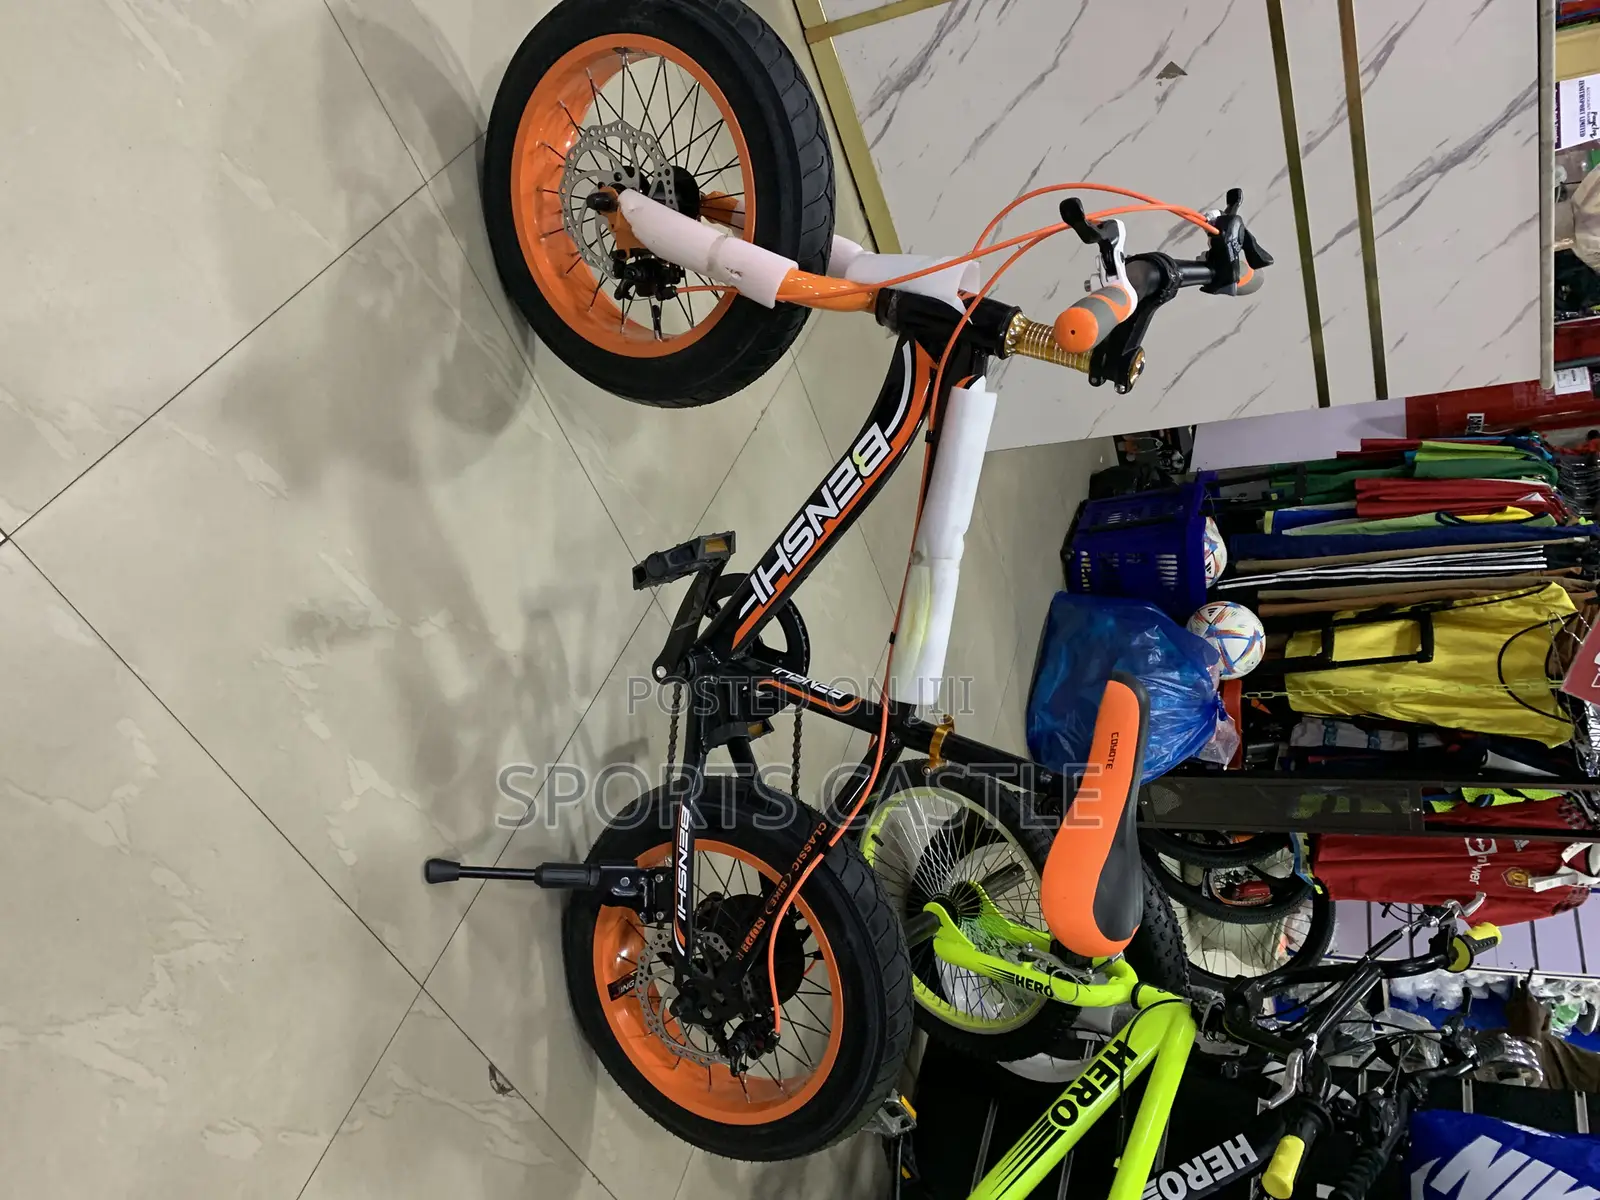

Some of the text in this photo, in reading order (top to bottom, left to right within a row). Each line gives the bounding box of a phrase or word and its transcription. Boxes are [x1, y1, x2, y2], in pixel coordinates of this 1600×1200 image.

[750, 422, 891, 604] BENSHI
[1106, 731, 1119, 770] COYOTE
[677, 805, 690, 921] BENSHI
[791, 821, 827, 871] CLASSIC
[1015, 974, 1054, 998] HERO
[1049, 1039, 1138, 1128] HERO
[1158, 1133, 1259, 1200] HERO
